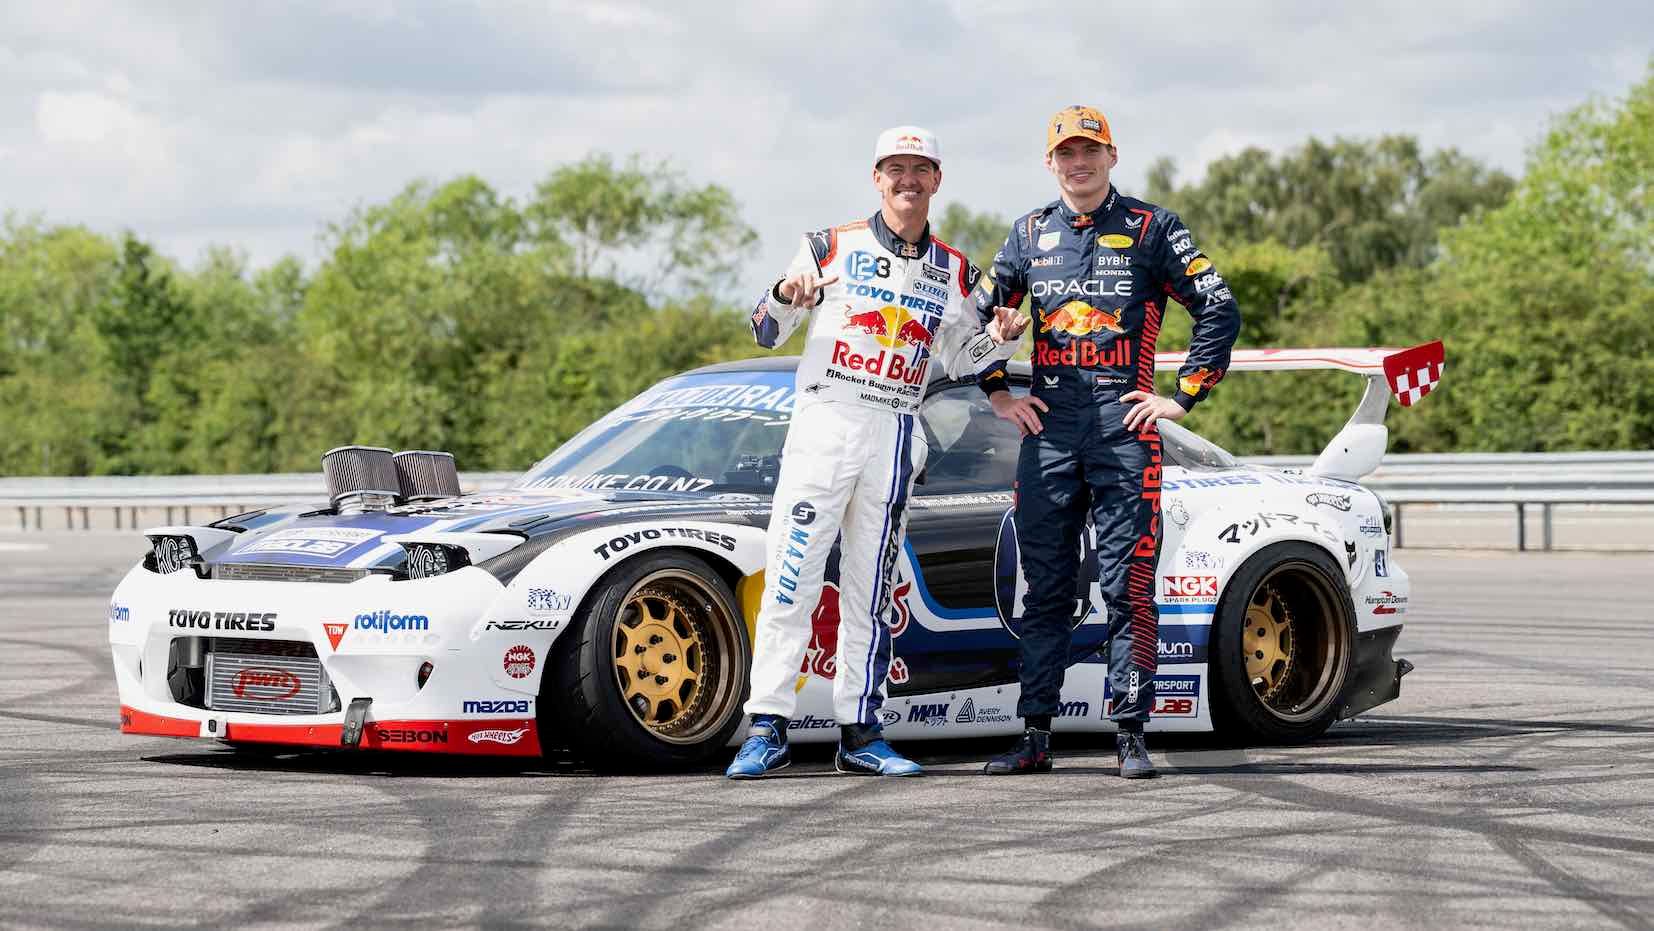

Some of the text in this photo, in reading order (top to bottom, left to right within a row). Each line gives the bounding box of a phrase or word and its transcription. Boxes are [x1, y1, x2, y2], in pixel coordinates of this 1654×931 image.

[1098, 254, 1132, 266] BYBIT
[1032, 280, 1134, 297] ORACLE
[846, 284, 895, 302] TOYO
[900, 294, 945, 317] TIRES
[832, 340, 928, 386] Red Bull
[1035, 339, 1131, 367] Red Bull
[593, 527, 737, 562] TOYO TIRES
[155, 538, 181, 575] KC
[776, 526, 810, 606] MAZDA
[1163, 577, 1217, 595] NGK
[168, 609, 277, 631] TOYO TIRES
[327, 624, 344, 635] TOW
[354, 610, 429, 633] rotiform
[508, 652, 531, 662] NGK
[976, 715, 1013, 724] DENNISON
[978, 708, 1001, 716] AVERY
[378, 729, 449, 744] SEBON
